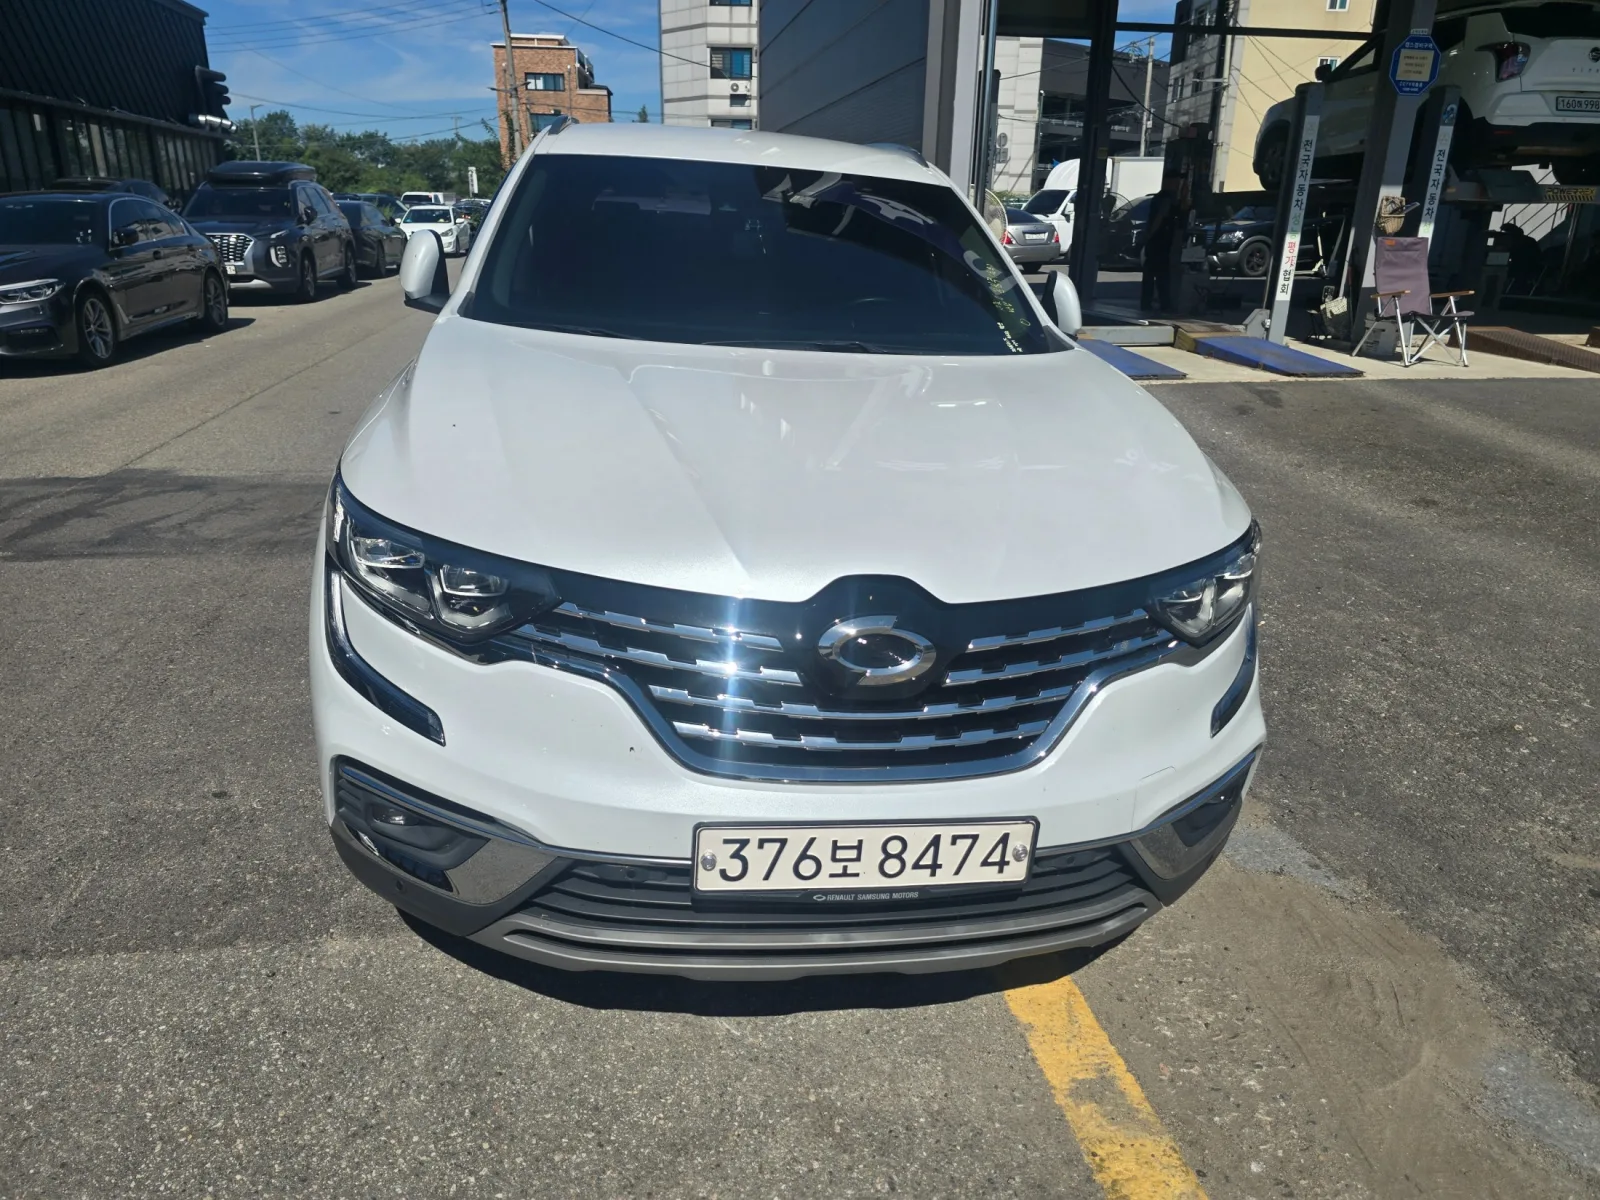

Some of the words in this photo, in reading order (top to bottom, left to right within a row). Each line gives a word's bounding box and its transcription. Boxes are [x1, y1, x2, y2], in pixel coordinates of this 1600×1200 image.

[827, 893, 855, 901] RENAULT
[857, 892, 890, 901] SAMSUNG
[892, 891, 919, 899] MOTORS
